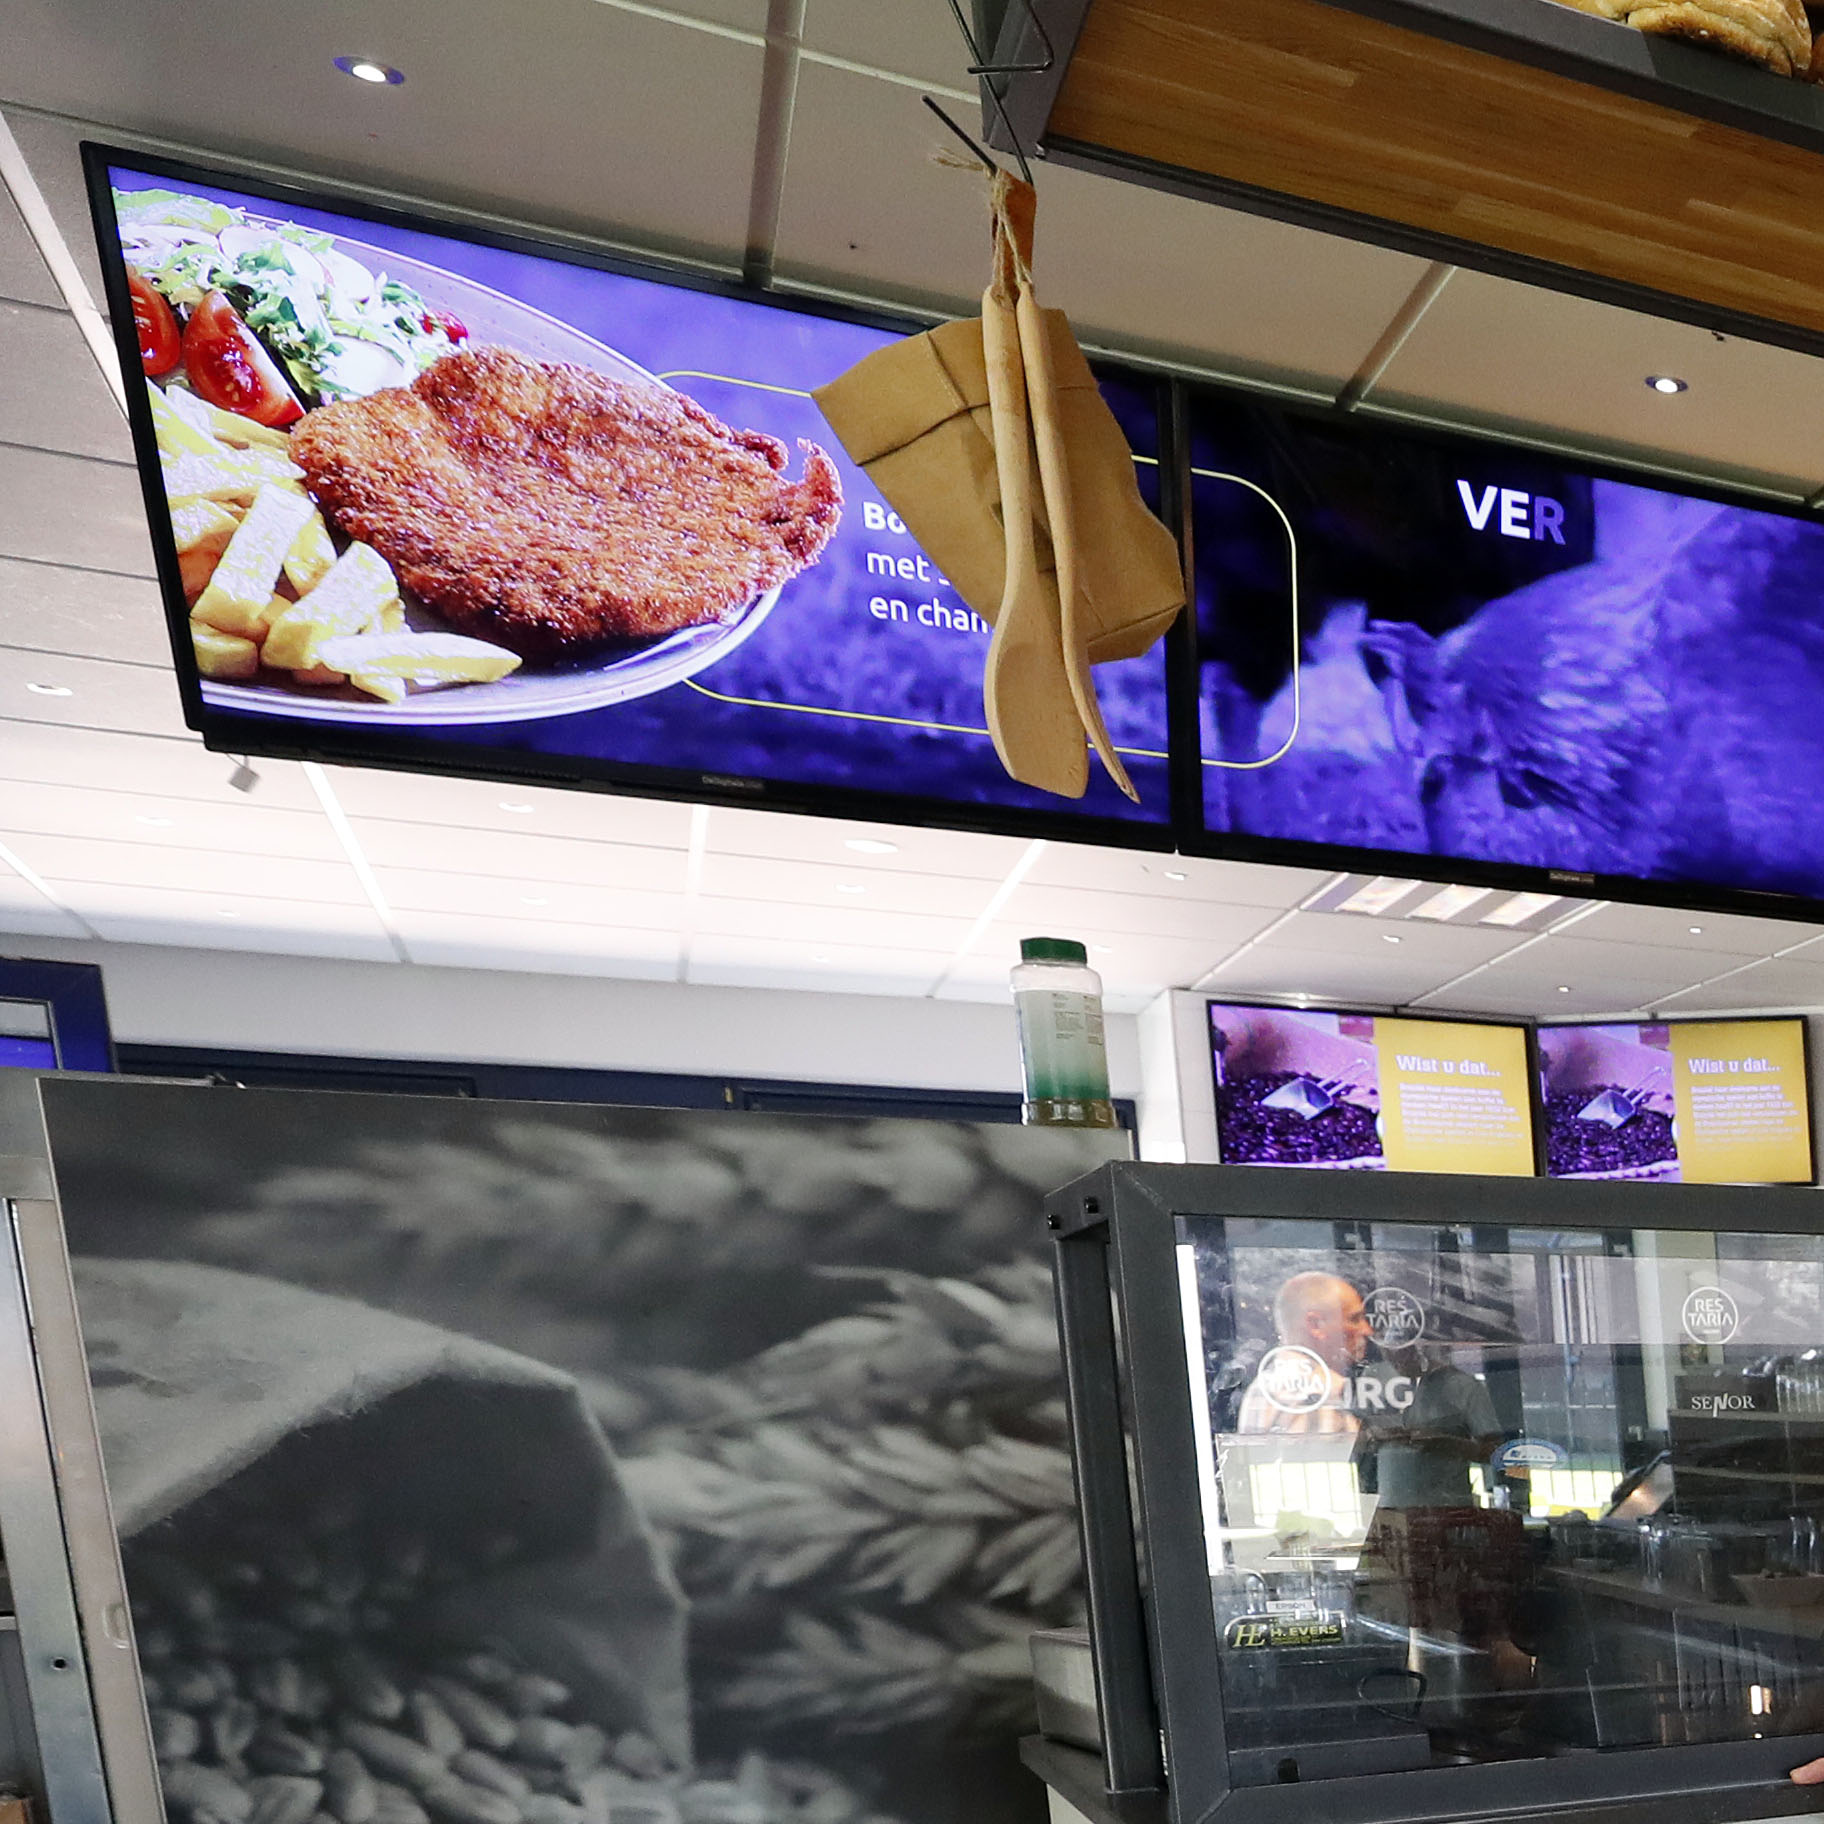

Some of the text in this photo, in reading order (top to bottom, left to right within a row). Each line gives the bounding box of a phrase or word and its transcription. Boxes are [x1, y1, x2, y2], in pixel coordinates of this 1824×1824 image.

[1457, 479, 1566, 545] VER
[867, 552, 931, 582] met
[869, 596, 909, 622] en
[1395, 1054, 1440, 1073] Wist
[1442, 1060, 1457, 1074] u
[1688, 1057, 1725, 1074] Wist
[1727, 1060, 1742, 1073] u
[1694, 1298, 1724, 1313] RES
[1687, 1312, 1734, 1327] TARIA
[1289, 1624, 1339, 1636] EVERS
